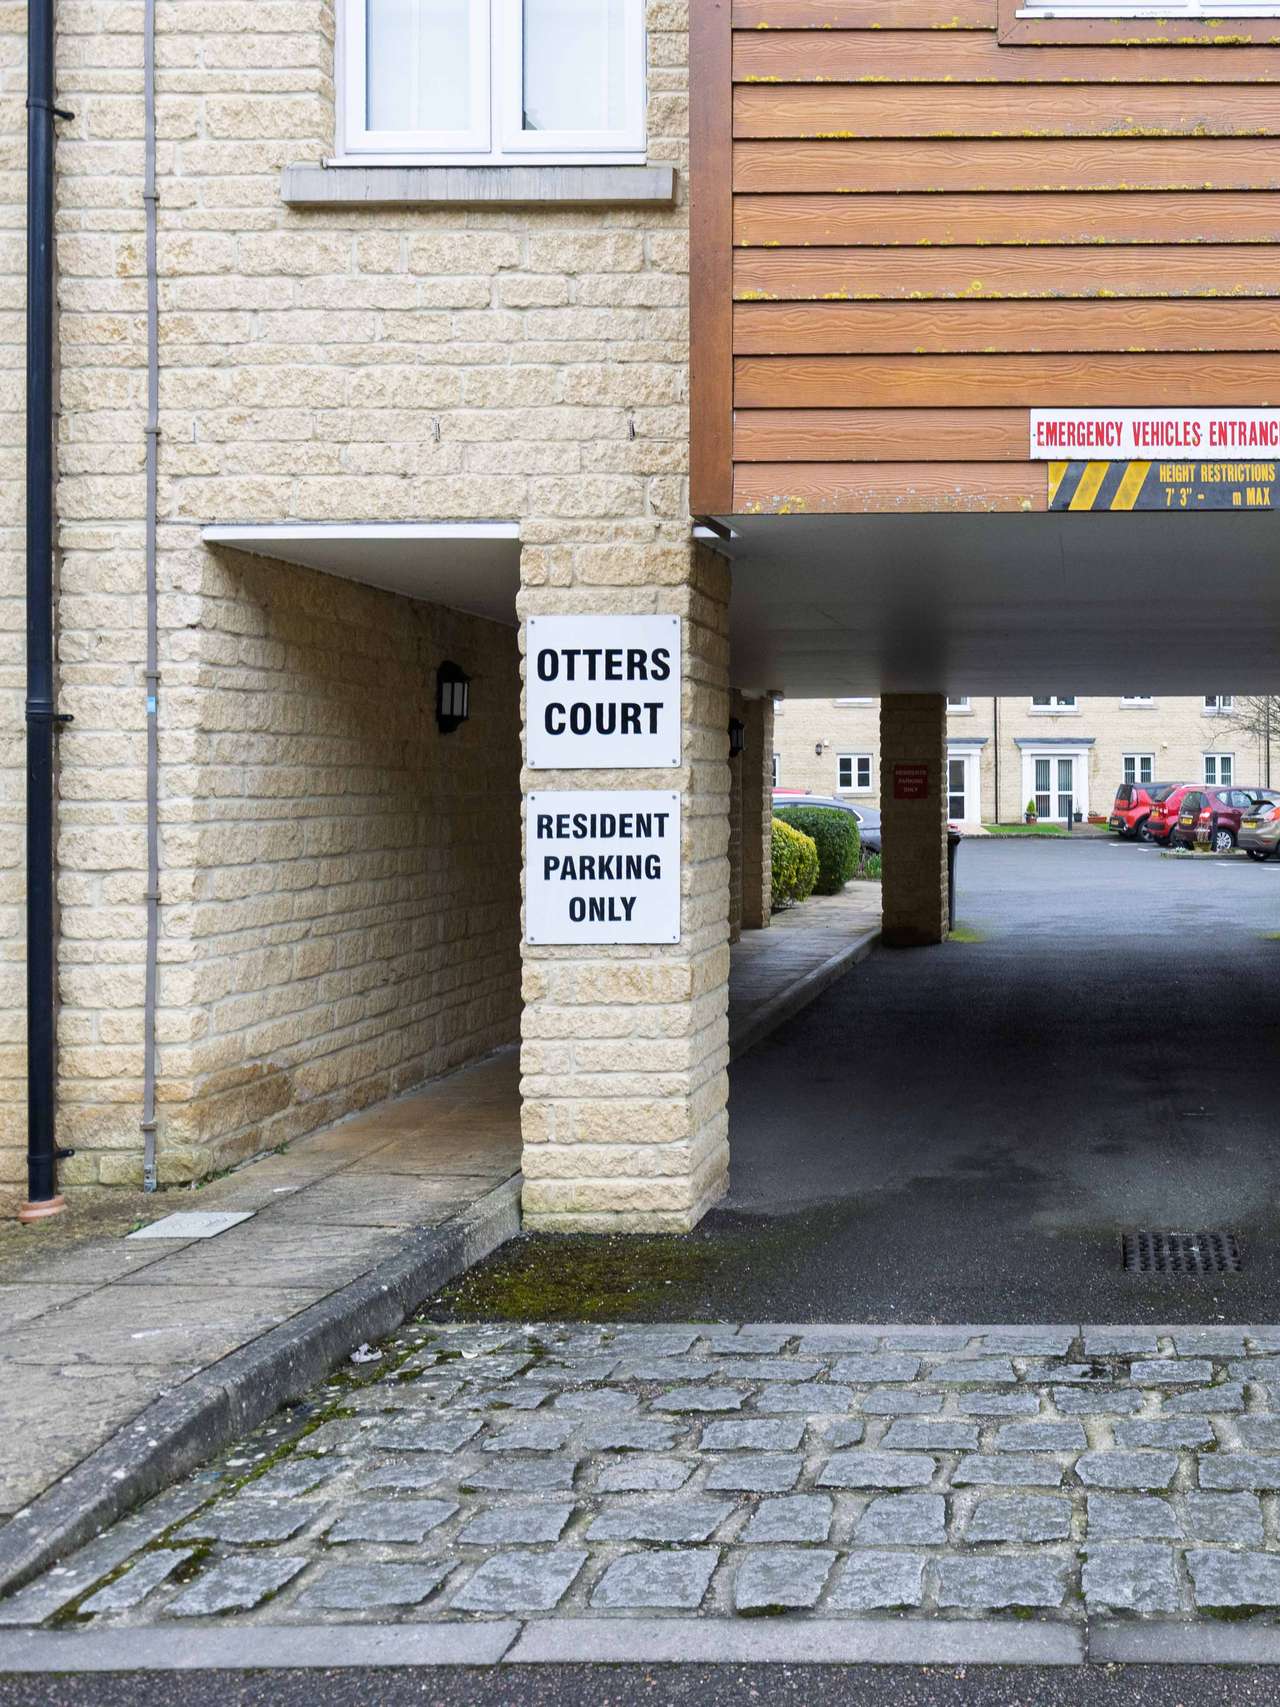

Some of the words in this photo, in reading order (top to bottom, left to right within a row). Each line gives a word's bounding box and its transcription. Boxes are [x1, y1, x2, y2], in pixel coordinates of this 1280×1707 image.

[1037, 421, 1122, 447] EMERGENCY
[1133, 421, 1200, 446] VEHICLES
[1159, 464, 1196, 482] HEIGHT
[1200, 464, 1275, 482] RESTRICTIONS
[1232, 492, 1241, 506] m
[1246, 487, 1270, 506] MAX
[538, 648, 670, 681] OTTERS
[545, 703, 663, 735] COURT
[538, 813, 669, 838] RESIDENT
[544, 855, 660, 880] PARKING
[570, 897, 636, 921] ONLY
